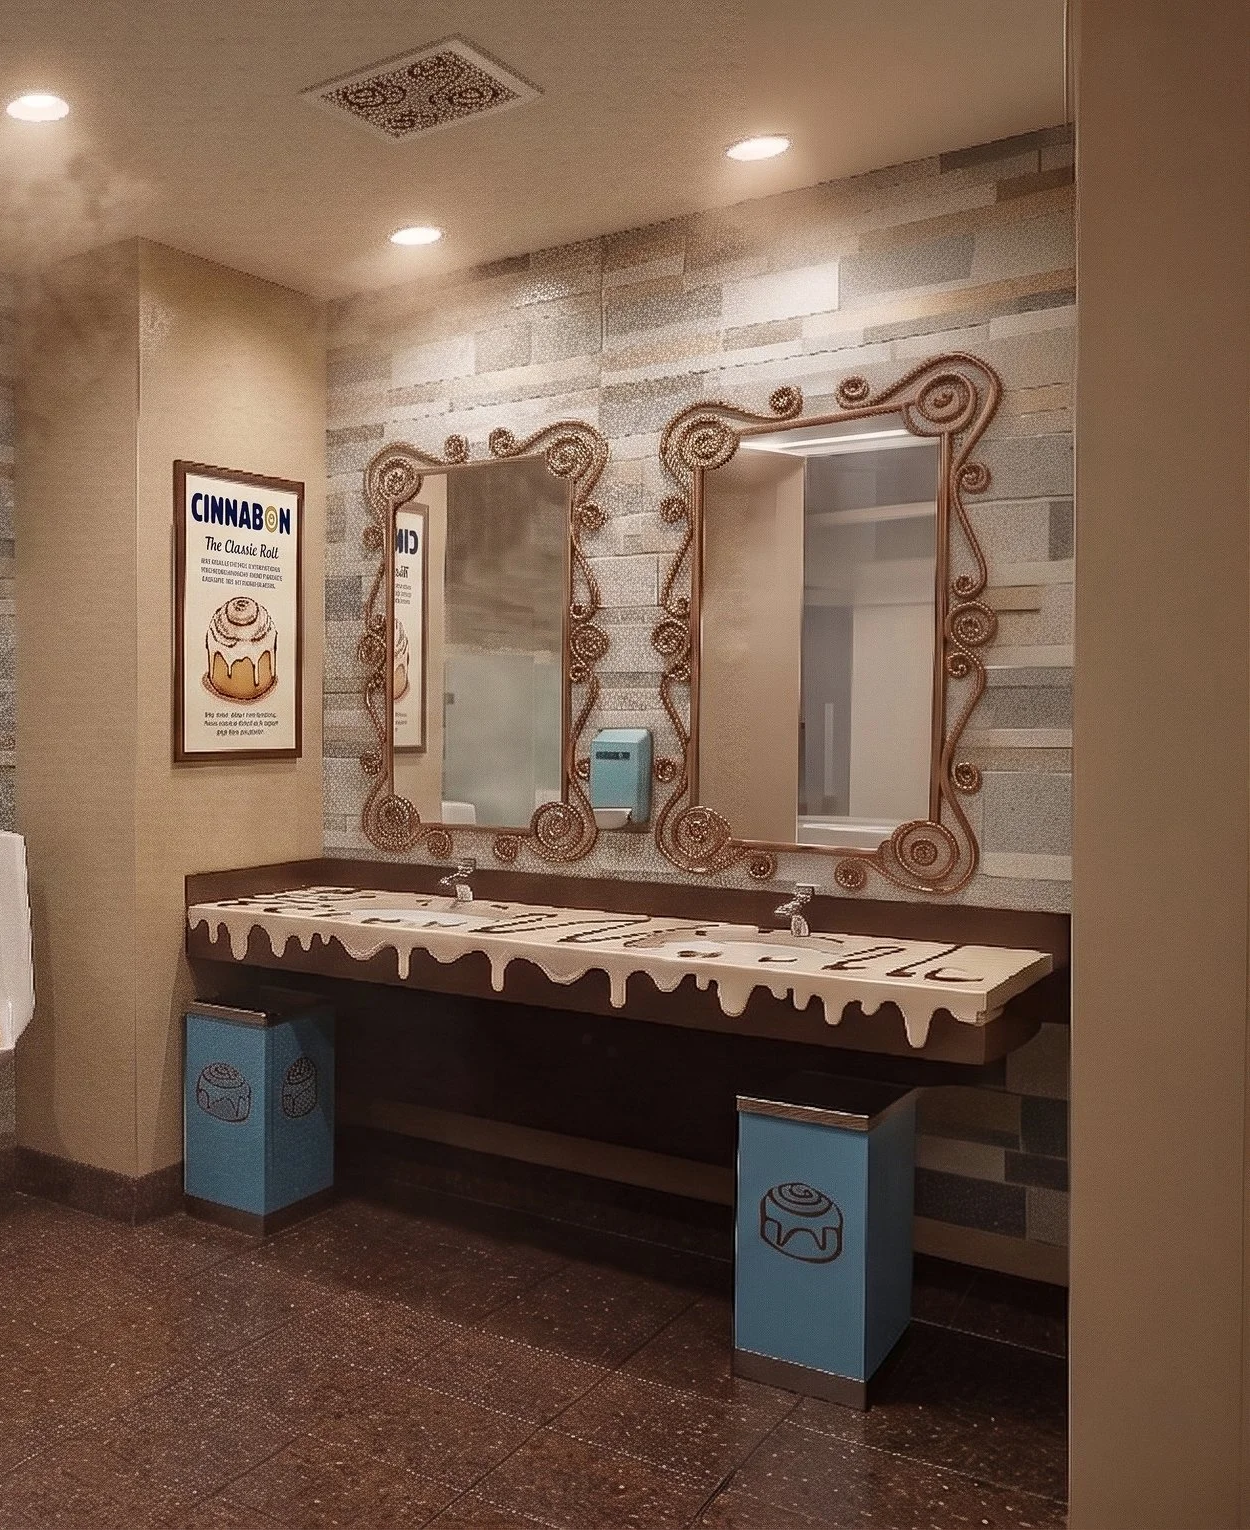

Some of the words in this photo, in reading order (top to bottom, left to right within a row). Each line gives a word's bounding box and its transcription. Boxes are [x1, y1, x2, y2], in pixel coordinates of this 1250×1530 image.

[191, 492, 291, 535] CINNABON
[205, 536, 223, 553] The
[224, 539, 258, 557] Classic
[259, 543, 280, 560] Roll
